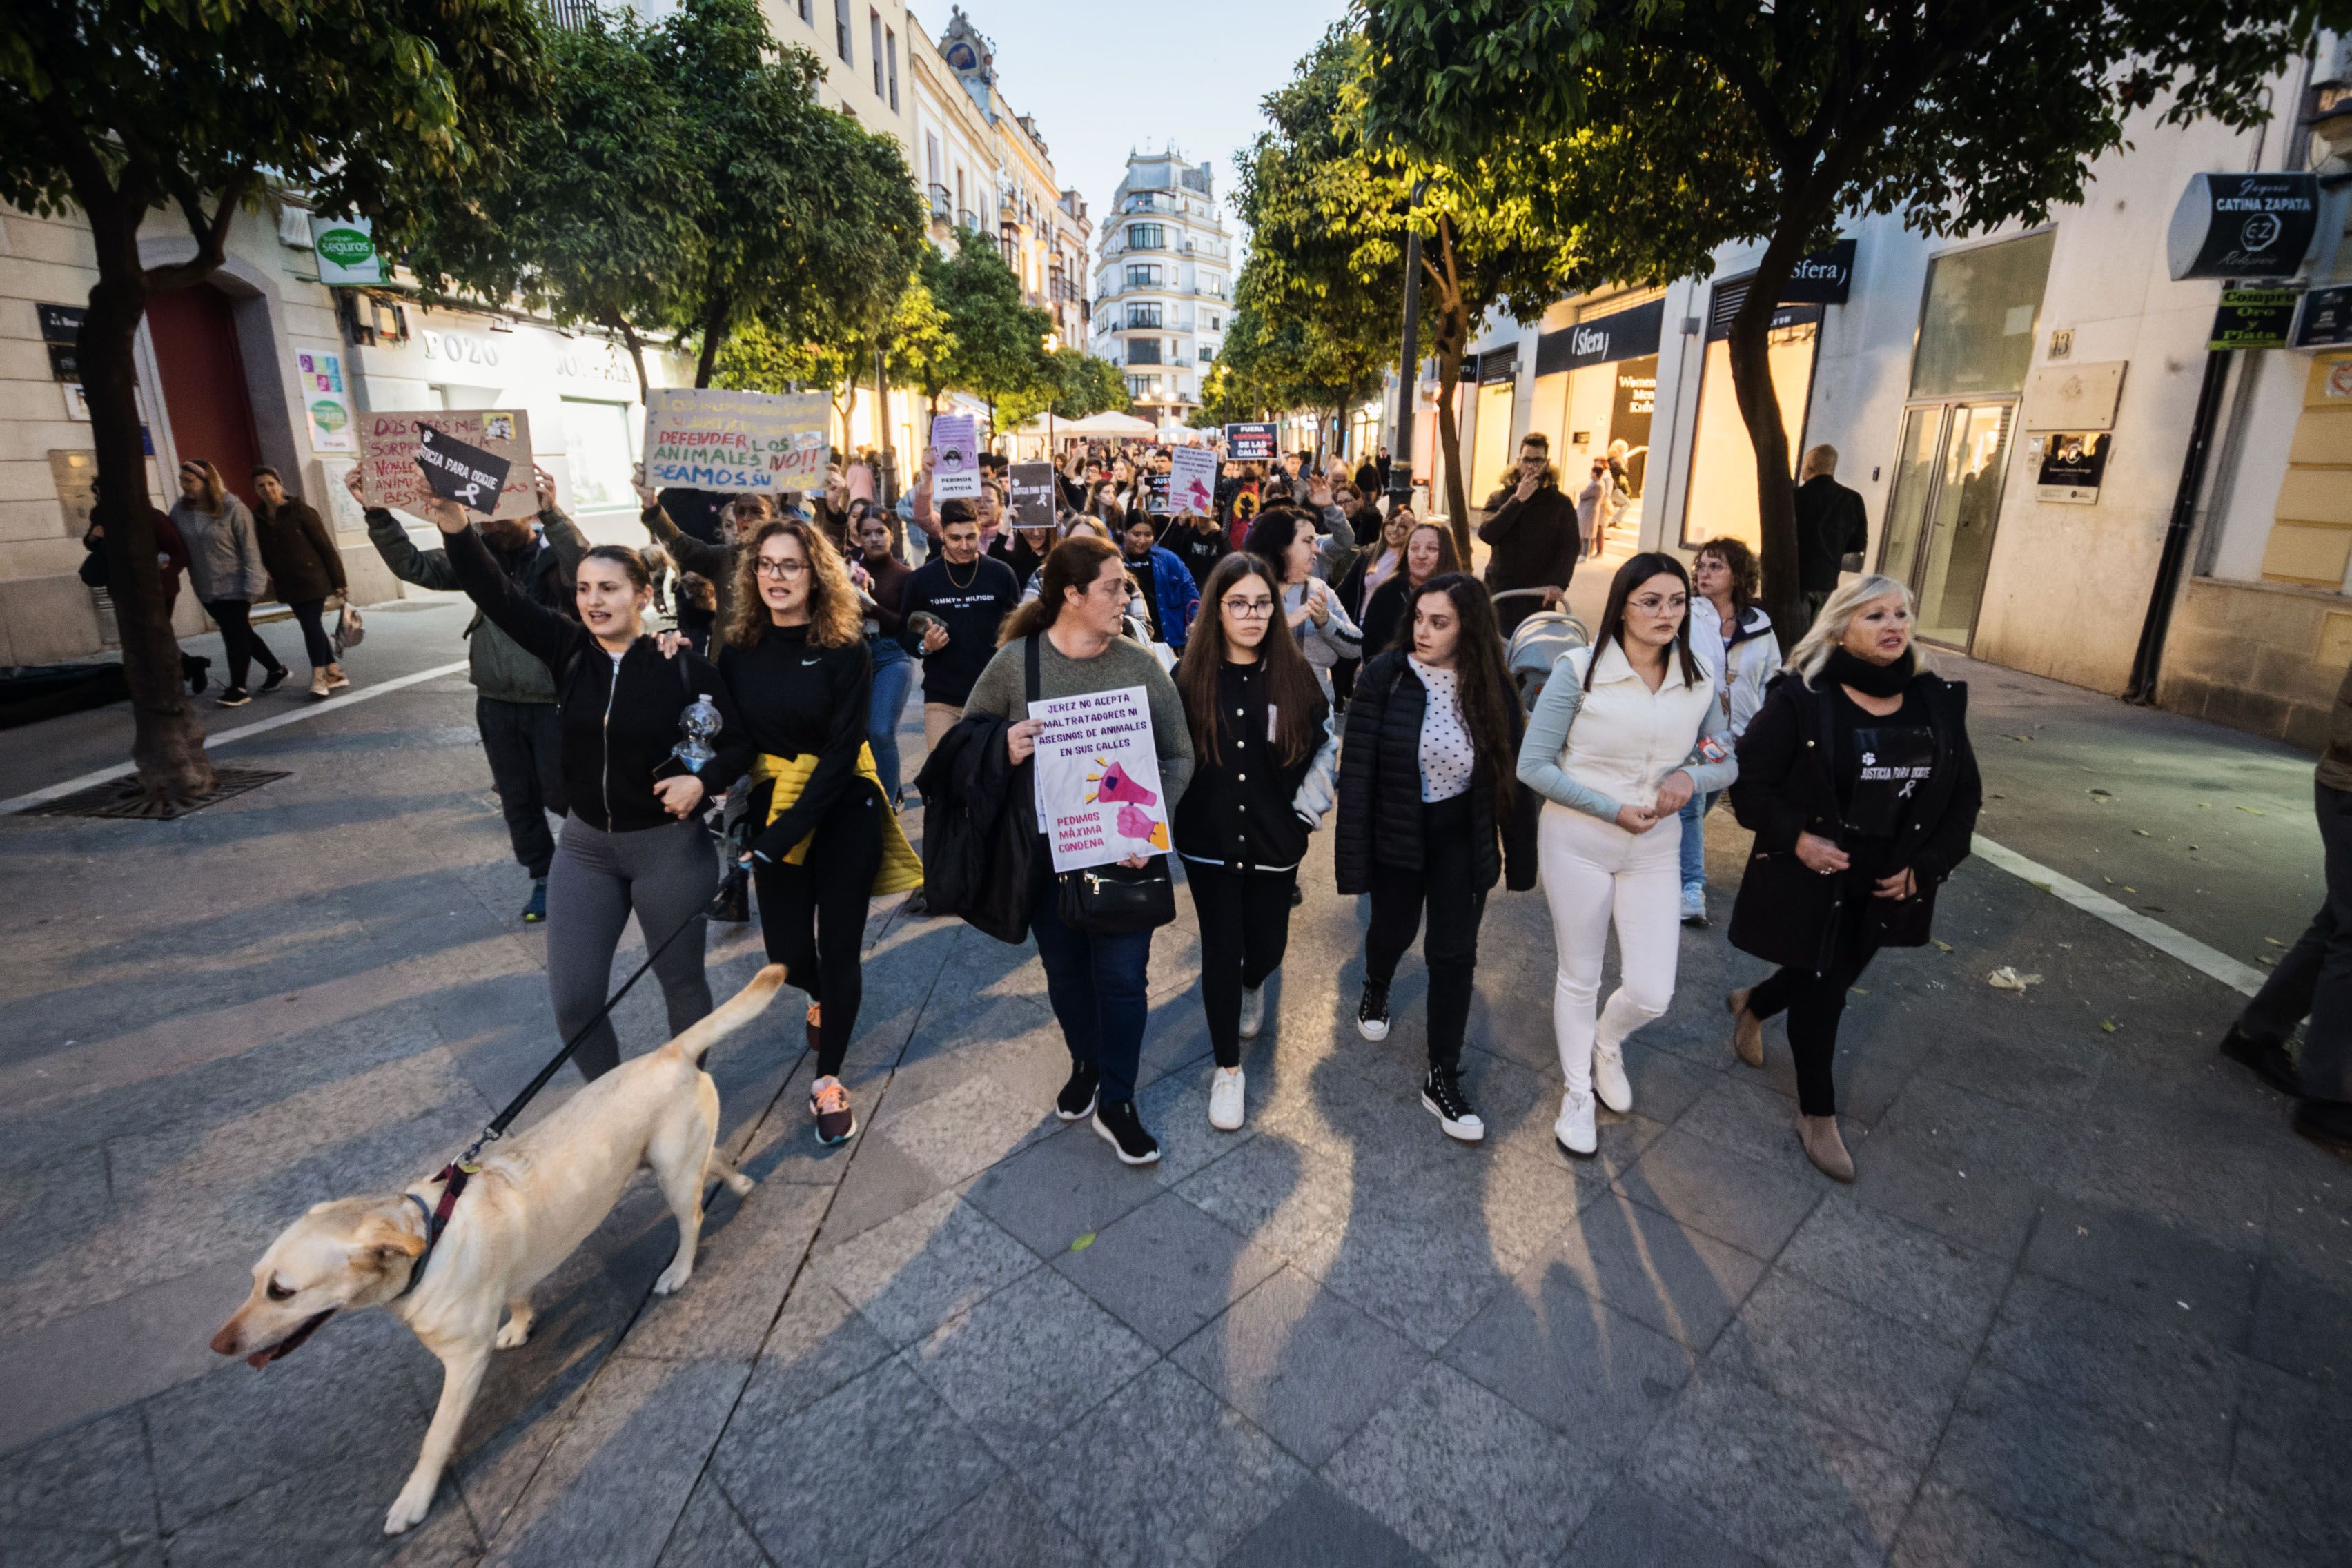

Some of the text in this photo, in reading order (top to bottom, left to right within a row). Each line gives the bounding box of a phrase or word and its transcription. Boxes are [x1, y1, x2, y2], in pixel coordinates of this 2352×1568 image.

[2216, 197, 2311, 211] CATINA ZAPATA
[322, 242, 369, 255] seguros
[2237, 307, 2275, 317] Oro
[2223, 330, 2277, 340] Plata
[421, 329, 499, 367] POZO
[2053, 333, 2070, 357] 13
[1618, 375, 1656, 388] Women
[1632, 389, 1655, 400] Men
[1629, 400, 1654, 413] Kids
[658, 431, 790, 453] DEFENDER LOS
[1238, 440, 1250, 449] DE
[654, 446, 763, 467] ANIMALES
[1237, 449, 1268, 457] CALLES
[444, 457, 469, 479] PARA
[471, 469, 498, 491] ODDIE
[653, 464, 747, 487] SEAMOS
[965, 594, 994, 602] HILFIGER
[1047, 694, 1130, 714] JEREZ NO ACEPTA
[1043, 708, 1138, 729] MALTRATADORES NI
[1039, 721, 1147, 745] ASESINOS DE ANIMALES
[1060, 738, 1130, 757] EN SUS CALLES
[1057, 812, 1100, 827] PEDIMOS
[1059, 825, 1102, 841] MÁXIMA
[1058, 840, 1104, 854] CONDENA
